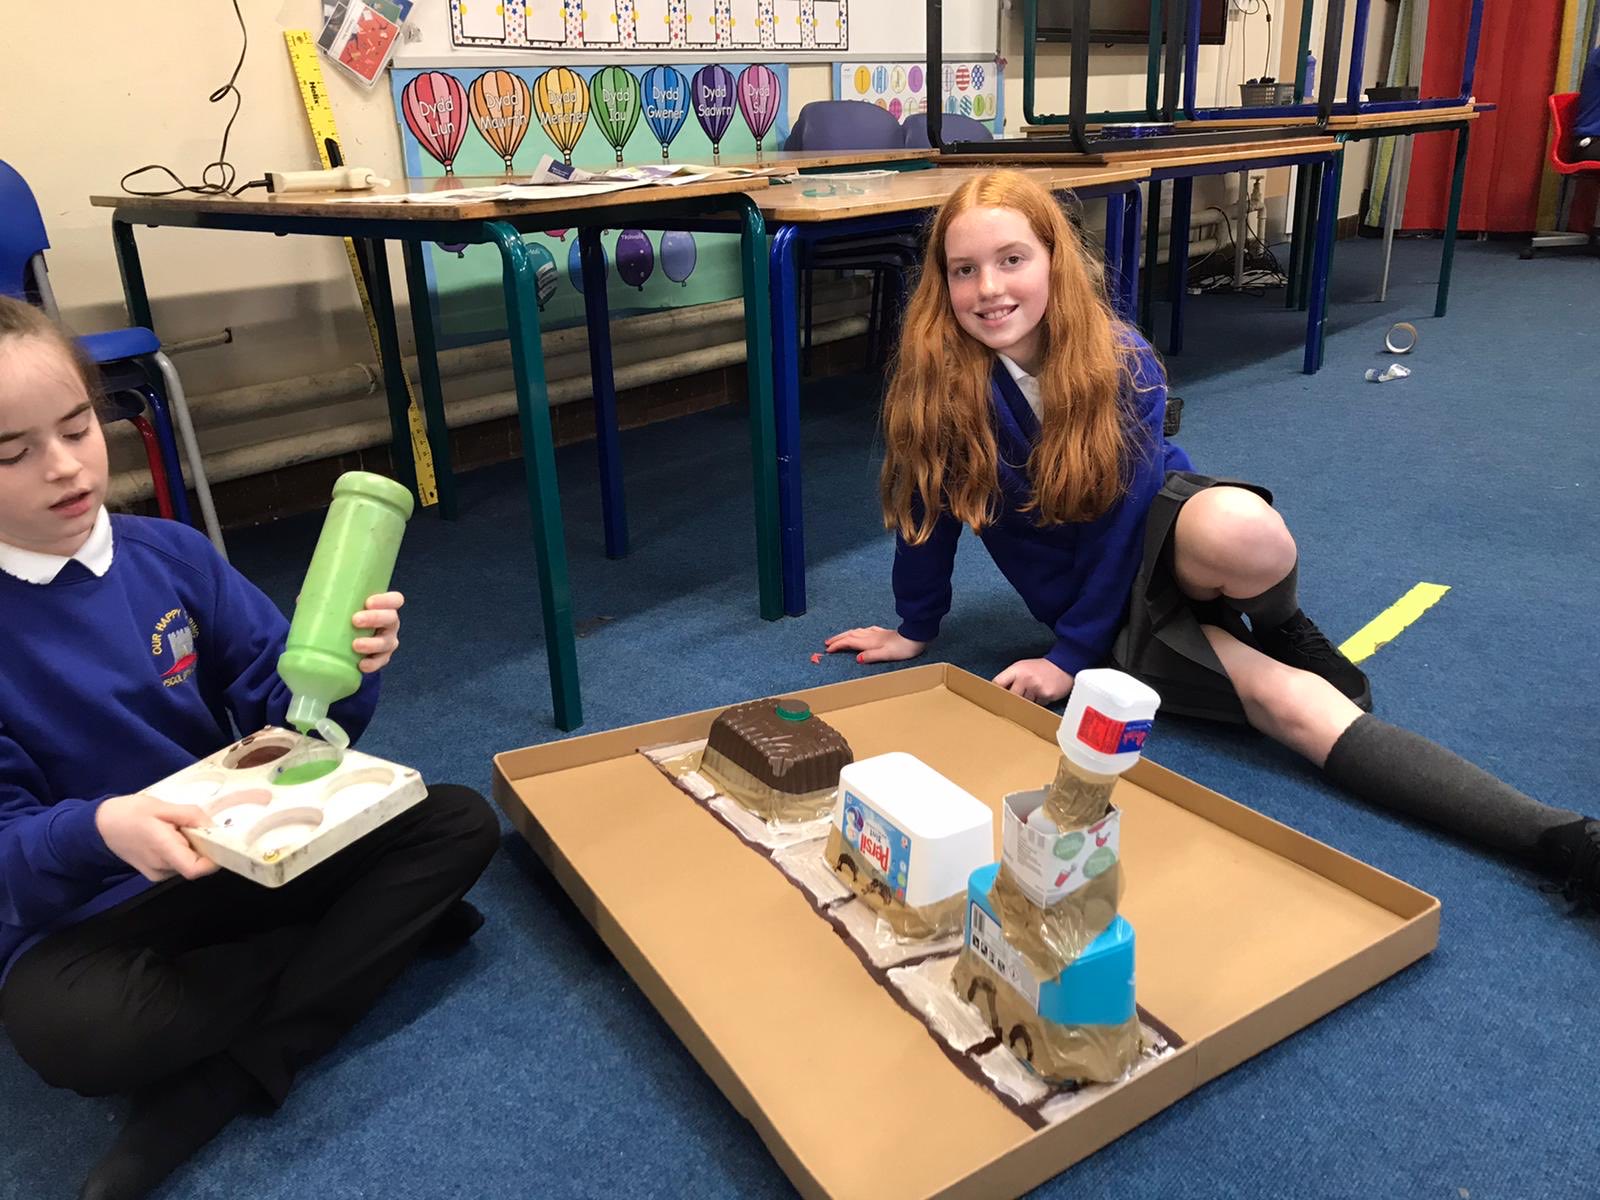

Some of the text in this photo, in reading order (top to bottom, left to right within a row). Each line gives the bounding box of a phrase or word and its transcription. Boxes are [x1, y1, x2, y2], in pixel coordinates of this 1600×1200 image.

[548, 88, 578, 107] Dydd
[602, 87, 630, 106] Dydd
[653, 86, 679, 103] Dydd
[703, 83, 727, 102] Dydd
[748, 83, 770, 100] Dydd
[418, 96, 454, 119] Dydd
[485, 92, 519, 111] Dydd
[698, 104, 732, 117] Sadwrn
[479, 111, 528, 131] Mawrth
[540, 110, 588, 126] Mercher
[608, 108, 626, 122] Iau
[647, 105, 684, 120] Gwener
[427, 120, 455, 137] Llun
[155, 608, 181, 631] HAPPY
[152, 633, 163, 655] OUR
[861, 834, 889, 872] Persil
